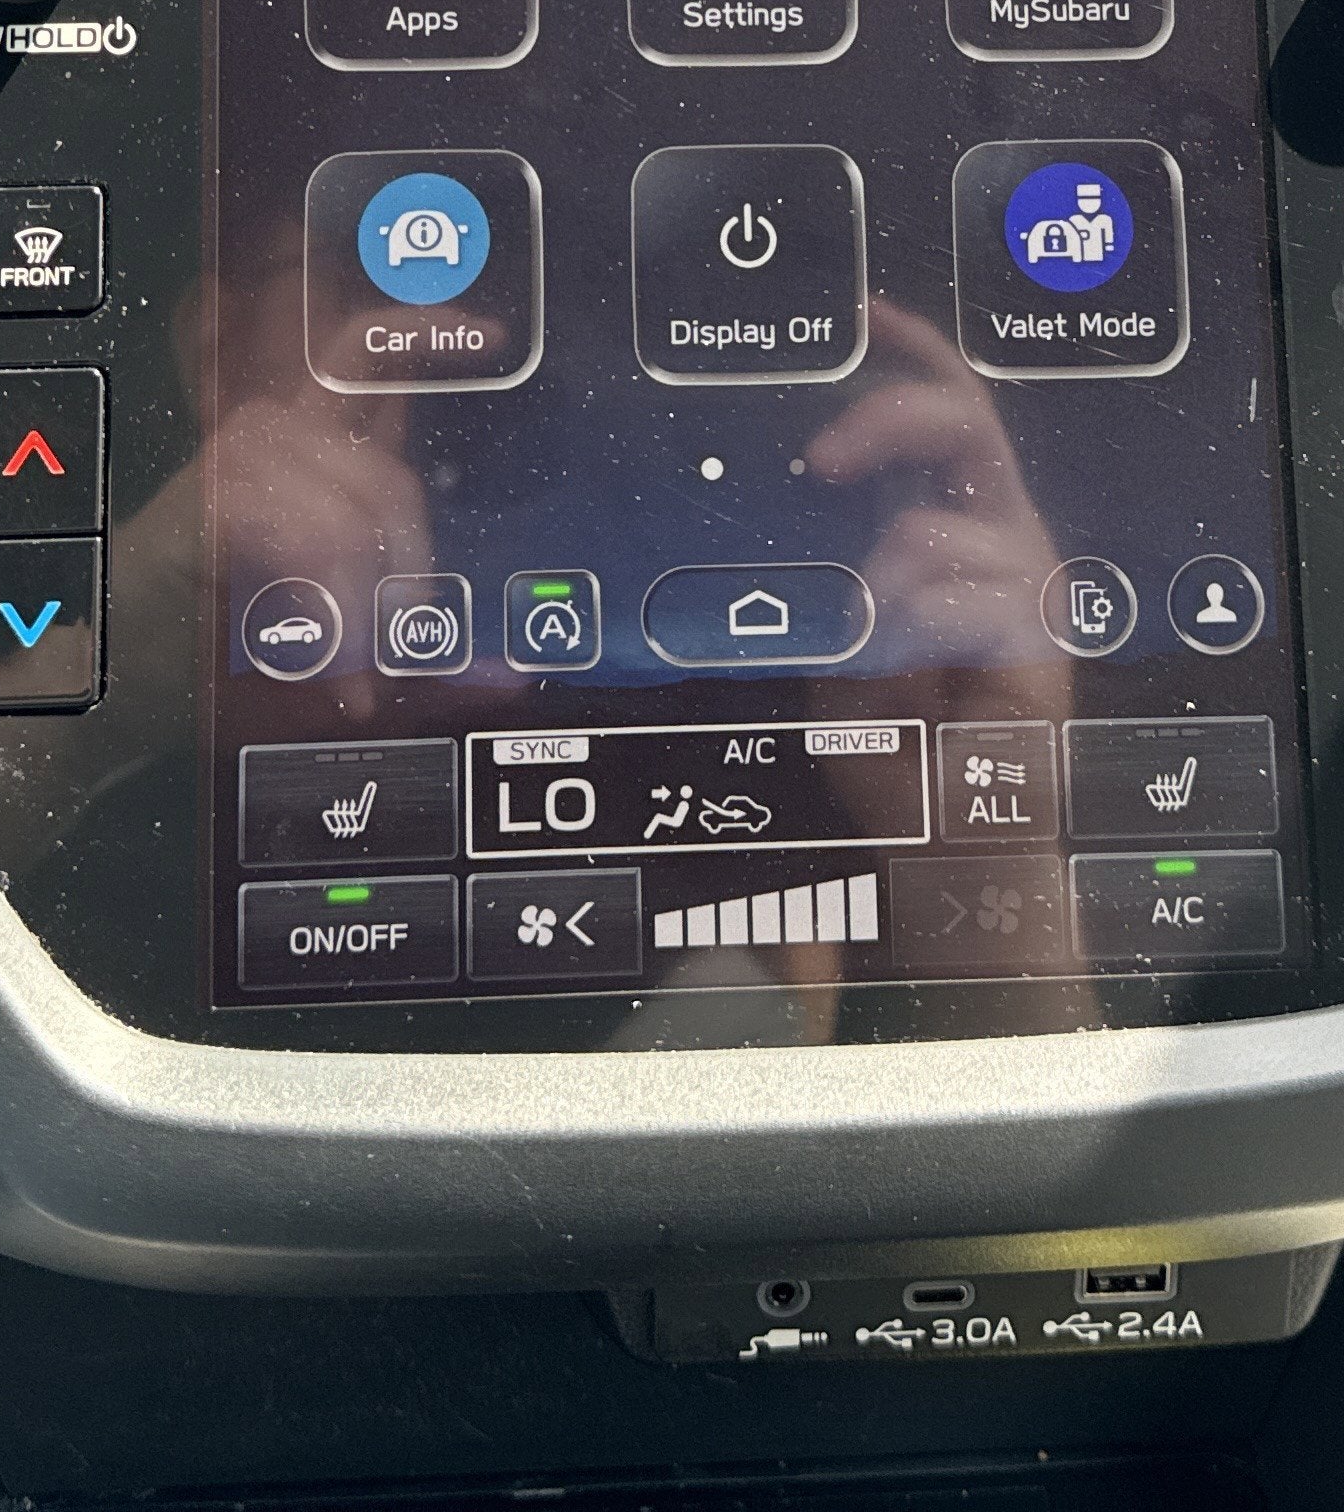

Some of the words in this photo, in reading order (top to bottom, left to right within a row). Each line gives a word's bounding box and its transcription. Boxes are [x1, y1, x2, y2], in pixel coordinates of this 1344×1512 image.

[385, 6, 459, 36] Apps
[682, 1, 804, 34] Settings
[0, 267, 74, 287] FRONT
[364, 326, 417, 353] Car
[430, 324, 485, 352] Info
[669, 319, 776, 350] Display
[787, 316, 833, 344] Off
[991, 311, 1068, 341] Valet
[1079, 310, 1156, 339] Mode
[405, 619, 444, 645] AVH
[510, 741, 573, 762] SYNC
[722, 737, 777, 767] A/C
[810, 731, 896, 752] DRIVER
[498, 778, 597, 833] LO
[967, 797, 1031, 825] ALL
[1151, 896, 1205, 926] A/C
[288, 923, 409, 956] ON/OFF
[930, 1318, 1017, 1344] 3.0A
[1118, 1312, 1204, 1338] 2.4A
